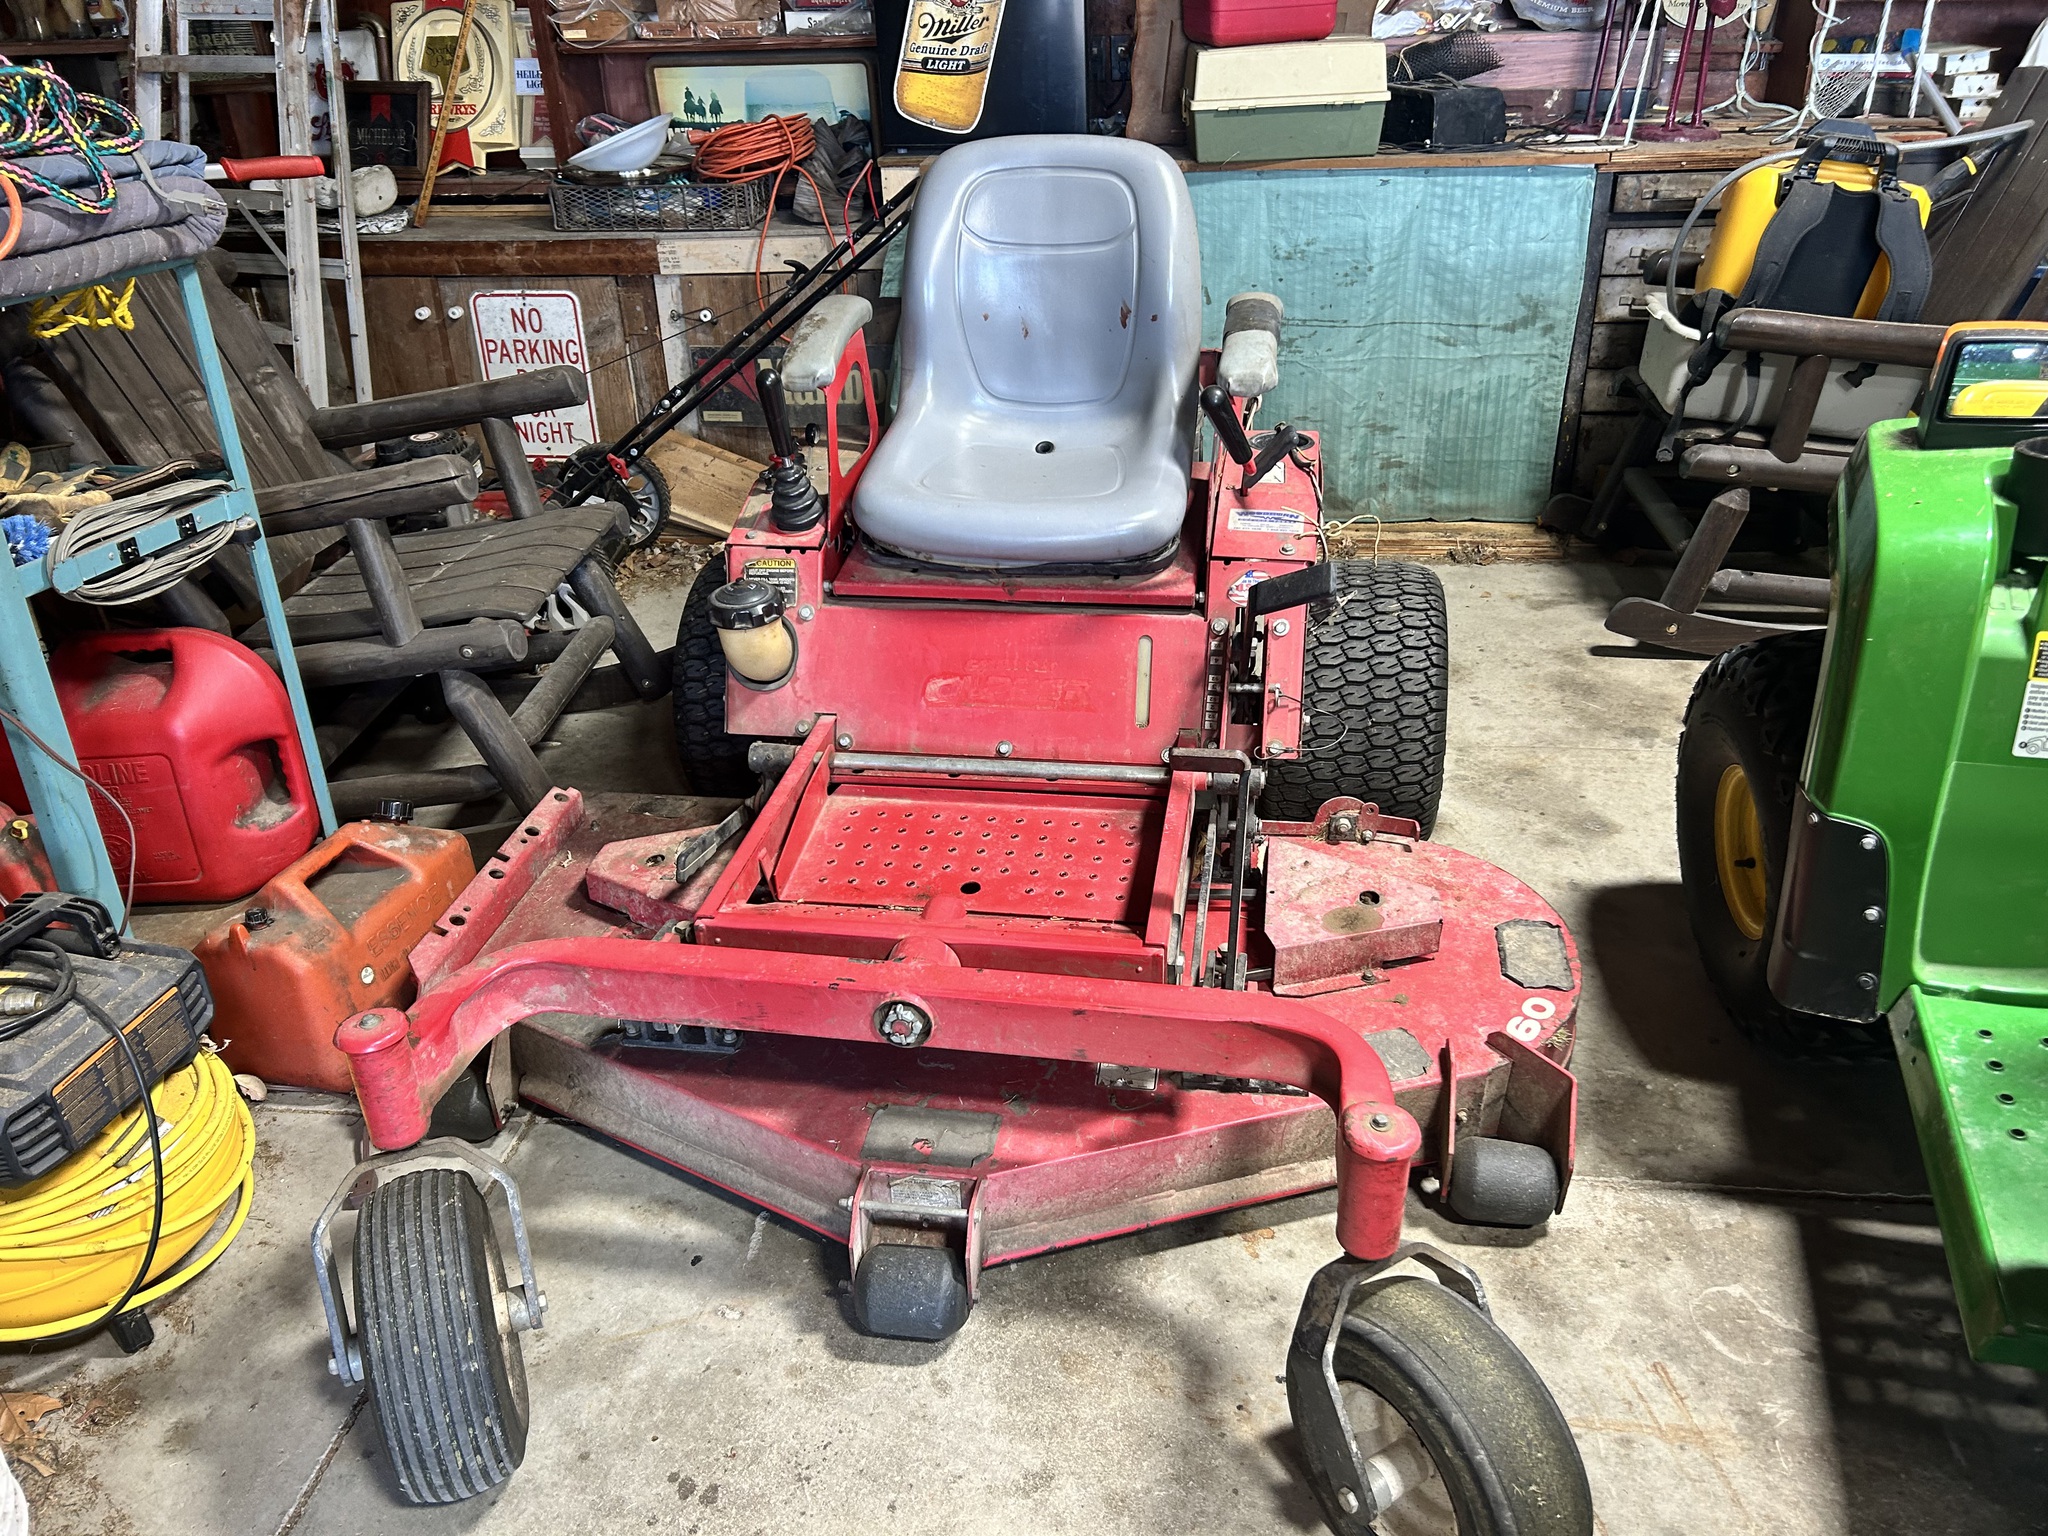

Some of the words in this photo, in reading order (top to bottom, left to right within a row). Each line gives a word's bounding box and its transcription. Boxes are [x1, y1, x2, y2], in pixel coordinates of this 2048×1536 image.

[918, 12, 990, 38] Miller
[909, 42, 957, 56] Genuine
[959, 42, 988, 56] Draft
[926, 59, 966, 71] LIGHT
[526, 79, 547, 89] LIG
[356, 127, 406, 146] MICHELOB
[510, 307, 543, 334] NO
[484, 339, 580, 365] PARKING
[515, 421, 575, 444] NIGHT
[81, 760, 150, 785] OLINE
[366, 883, 442, 958] ESSENCE
[1505, 996, 1556, 1042] 60
